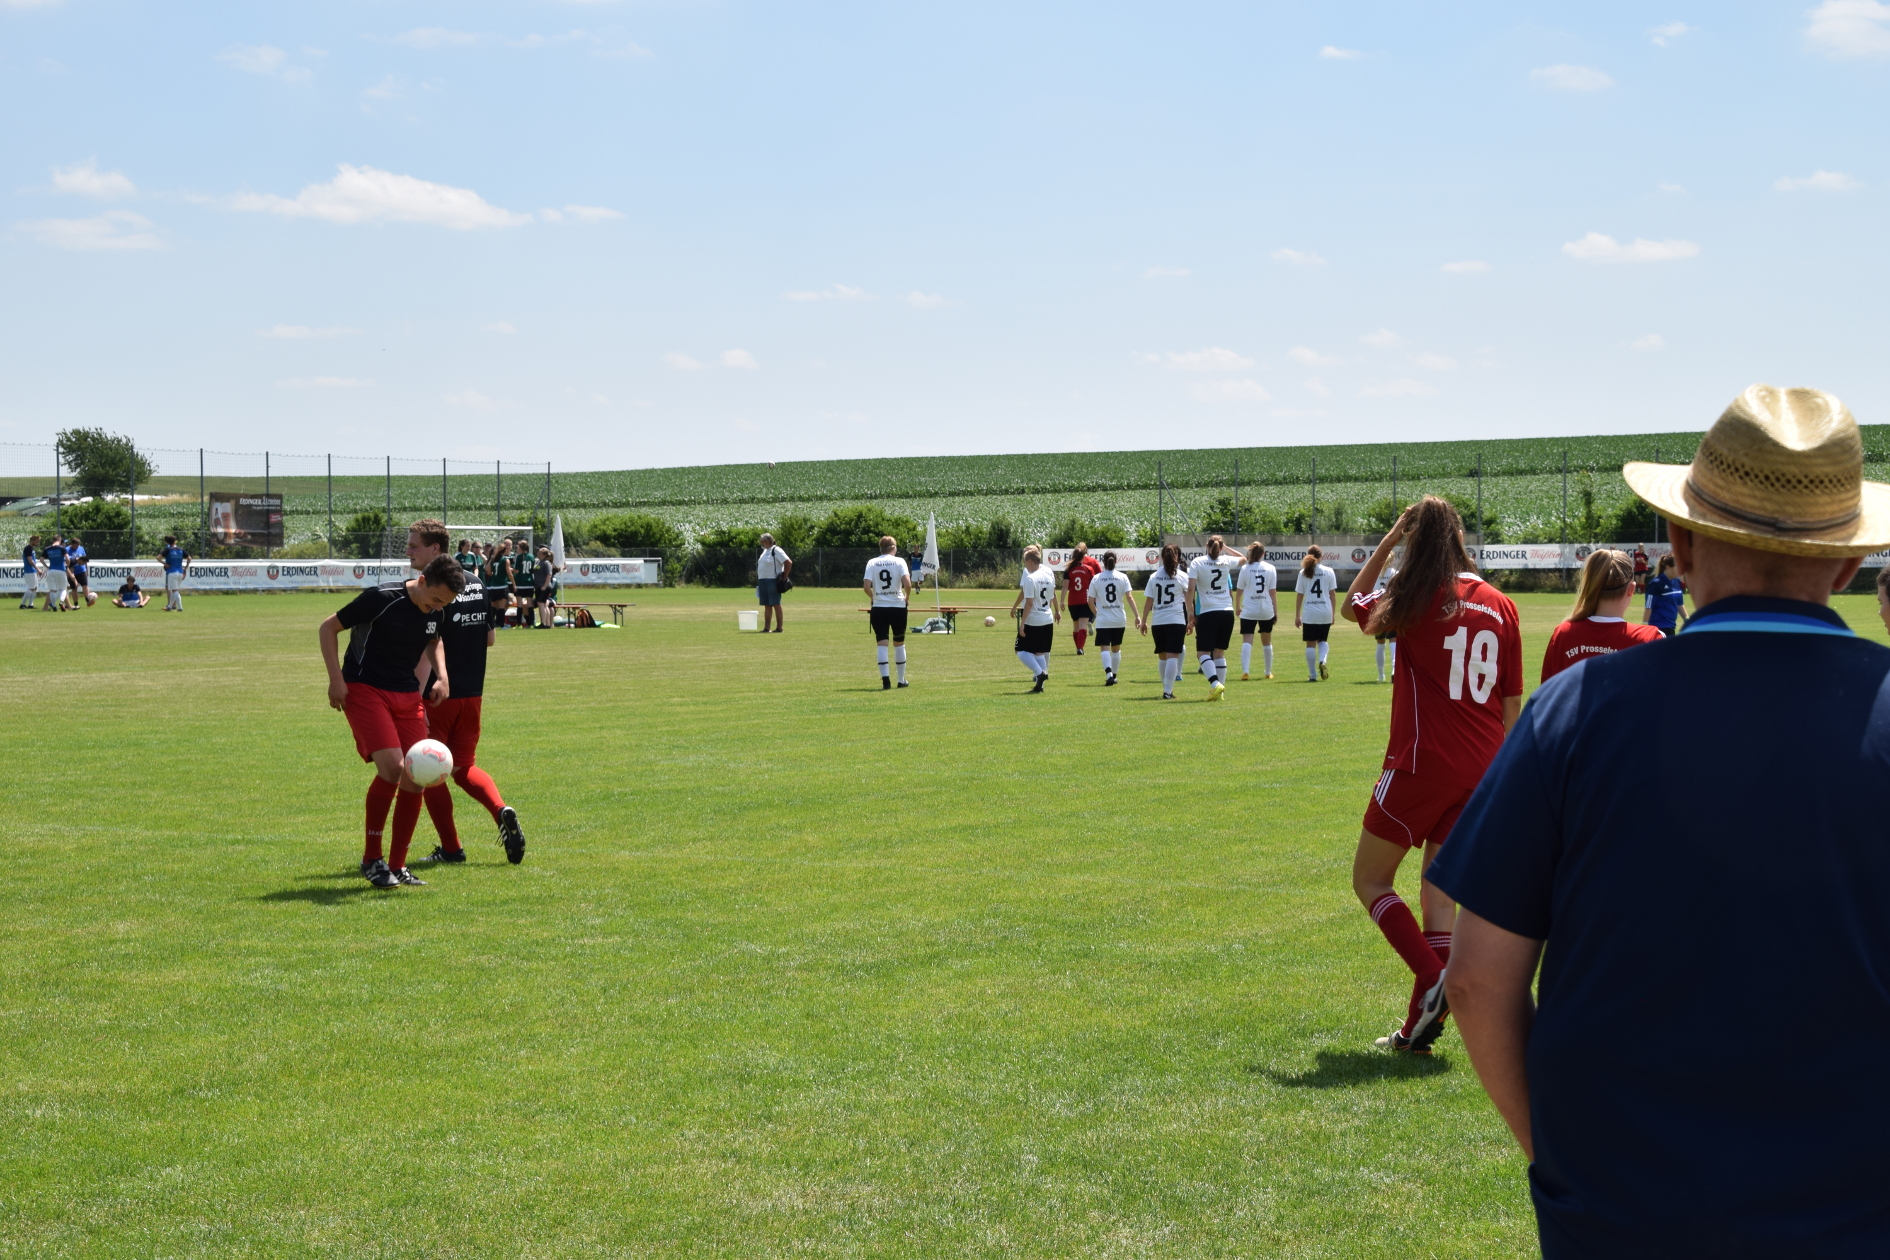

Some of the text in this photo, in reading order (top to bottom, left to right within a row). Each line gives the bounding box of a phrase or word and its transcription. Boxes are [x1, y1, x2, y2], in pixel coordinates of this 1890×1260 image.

[1480, 550, 1527, 560] ERDINGER
[89, 566, 131, 579] ERDINGER
[189, 566, 229, 578] ERDINGER
[281, 566, 319, 577] ERDINGER
[522, 560, 532, 574] 10
[591, 563, 620, 574] ERDINGER
[879, 569, 892, 590] 9
[1074, 577, 1082, 591] 3
[1211, 569, 1222, 590] 2
[1255, 574, 1265, 594] 3
[1105, 583, 1116, 603] 8
[1155, 583, 1175, 605] 15
[1310, 579, 1322, 599] 4
[1442, 599, 1504, 625] TSV Prosselsheim
[1565, 647, 1579, 659] TSV
